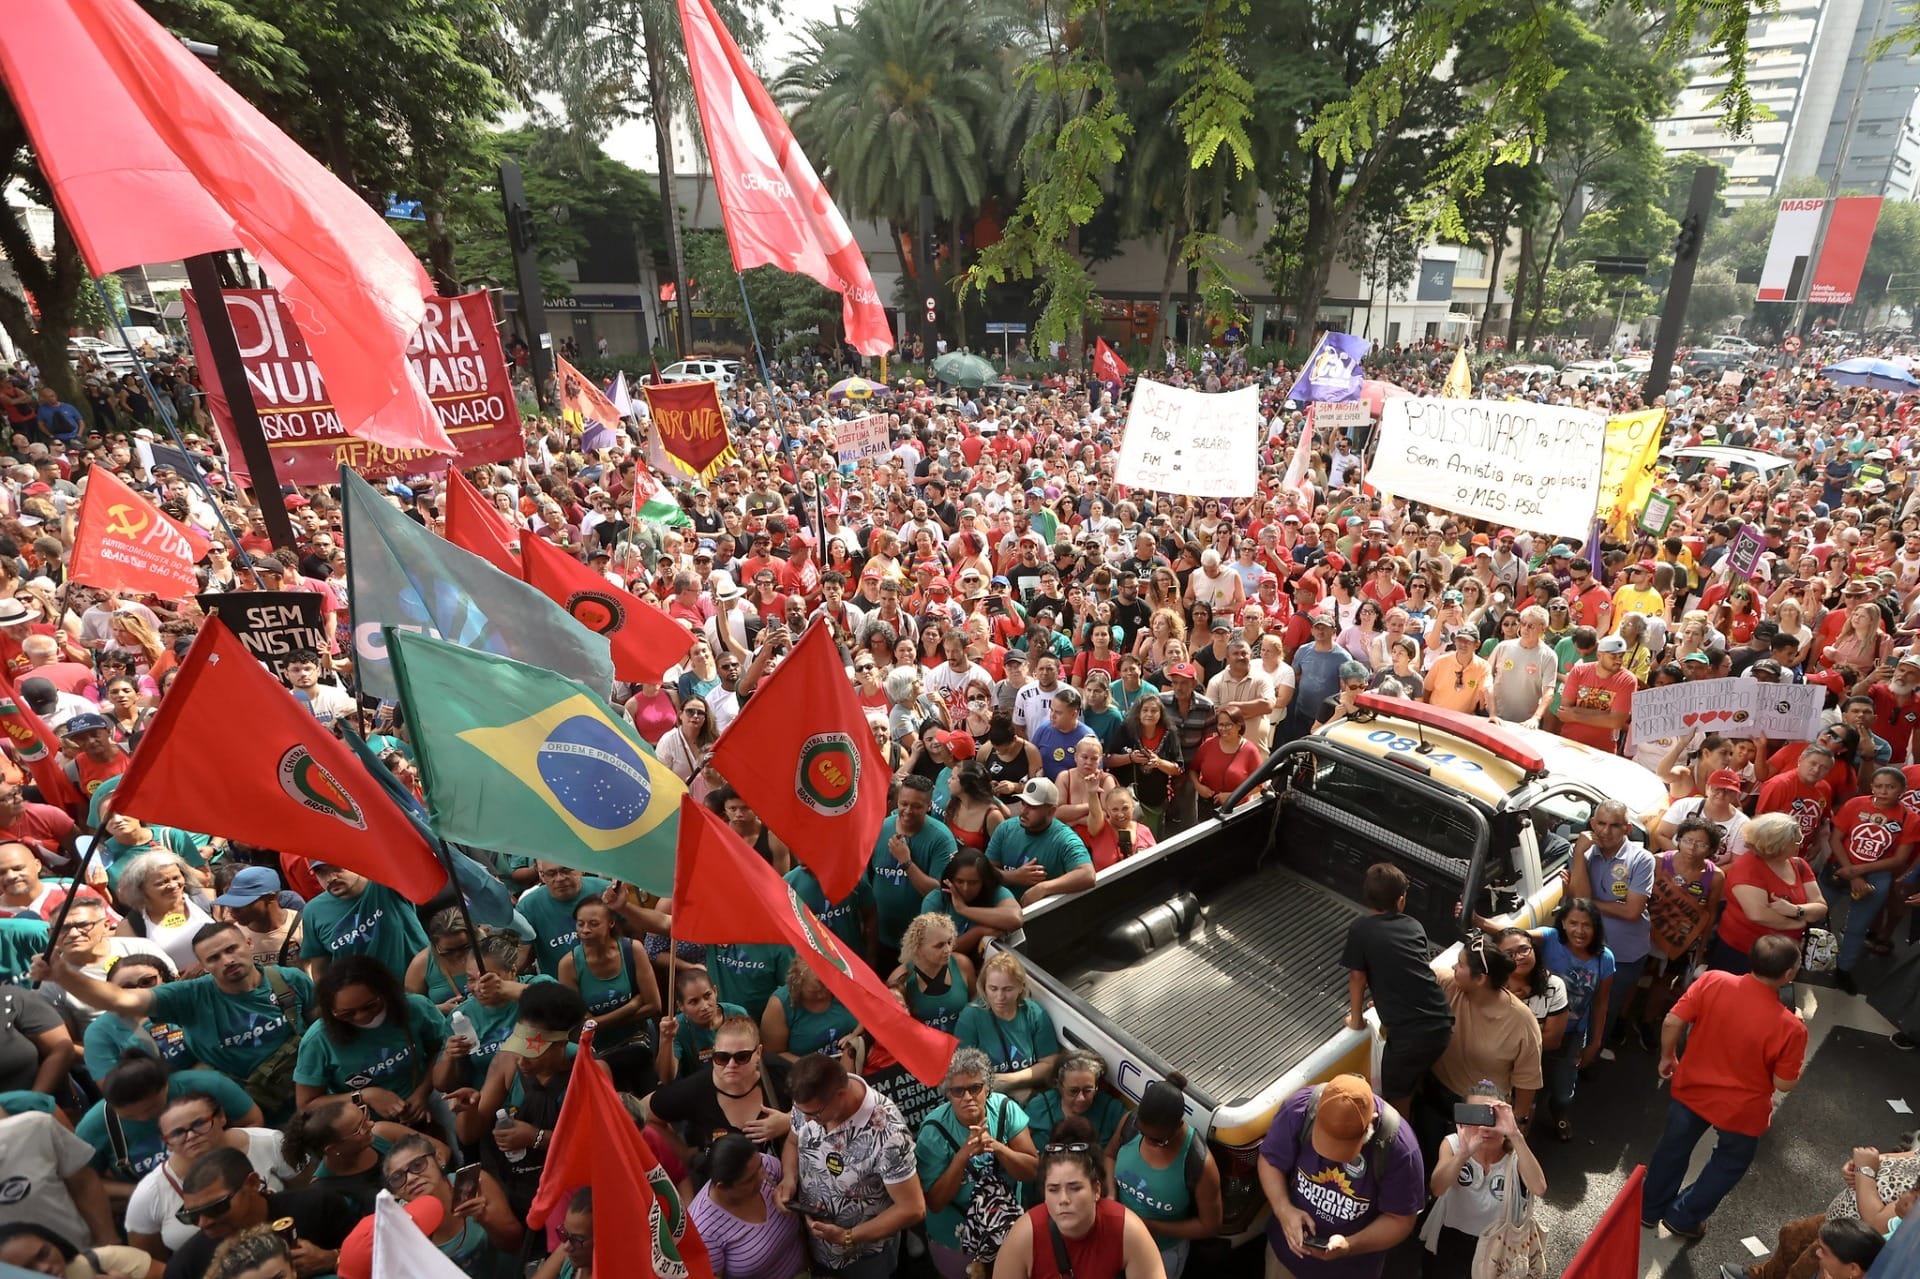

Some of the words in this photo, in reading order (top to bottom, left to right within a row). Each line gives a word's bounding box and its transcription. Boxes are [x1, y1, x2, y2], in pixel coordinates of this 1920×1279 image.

[1781, 200, 1824, 211] MASP
[1150, 426, 1171, 442] POR
[1403, 399, 1538, 463] BOLSONARO
[839, 440, 887, 462] MALAFAIA
[1142, 452, 1162, 466] FIM
[1406, 445, 1439, 470] Sem
[1446, 453, 1505, 483] Anistia
[1511, 473, 1534, 489] pra
[1136, 470, 1170, 485] CST
[1470, 488, 1507, 512] MES
[1514, 498, 1544, 515] PSOL
[172, 571, 199, 589] PAUL
[246, 605, 304, 629] SEM
[238, 628, 326, 655] NISTIA
[547, 743, 586, 754] ORDEM
[596, 751, 648, 787] PROGRESSO
[818, 759, 848, 787] CMP
[303, 799, 336, 816] BRASIL
[797, 787, 817, 808] BRASIL
[875, 867, 908, 877] CEPRO
[331, 909, 384, 951] CEPROCIG
[549, 931, 578, 948] CEPR
[716, 954, 766, 970] CEPROCIG
[589, 992, 633, 1012] EPROCI
[1315, 1209, 1335, 1224] PSOL
